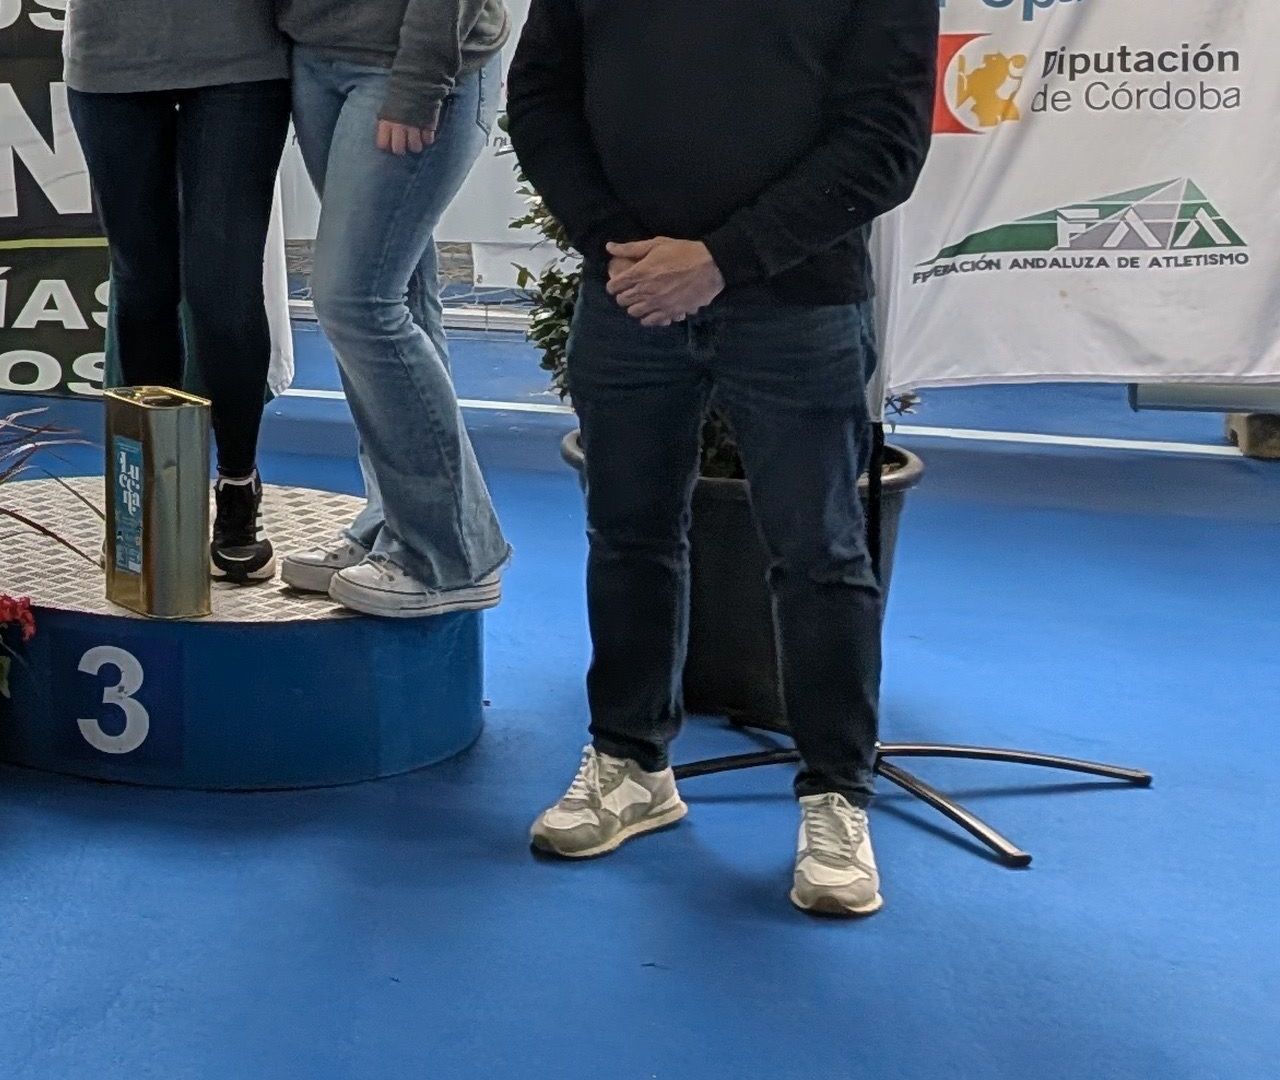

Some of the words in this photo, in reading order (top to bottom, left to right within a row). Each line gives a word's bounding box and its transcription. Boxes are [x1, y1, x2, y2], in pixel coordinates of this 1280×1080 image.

[1030, 83, 1071, 112] de
[1084, 80, 1241, 111] Córdoba
[1009, 256, 1109, 270] ANDALUZA
[1117, 256, 1140, 269] DE
[1148, 252, 1249, 269] ATLETISMO
[77, 645, 151, 755] 3
